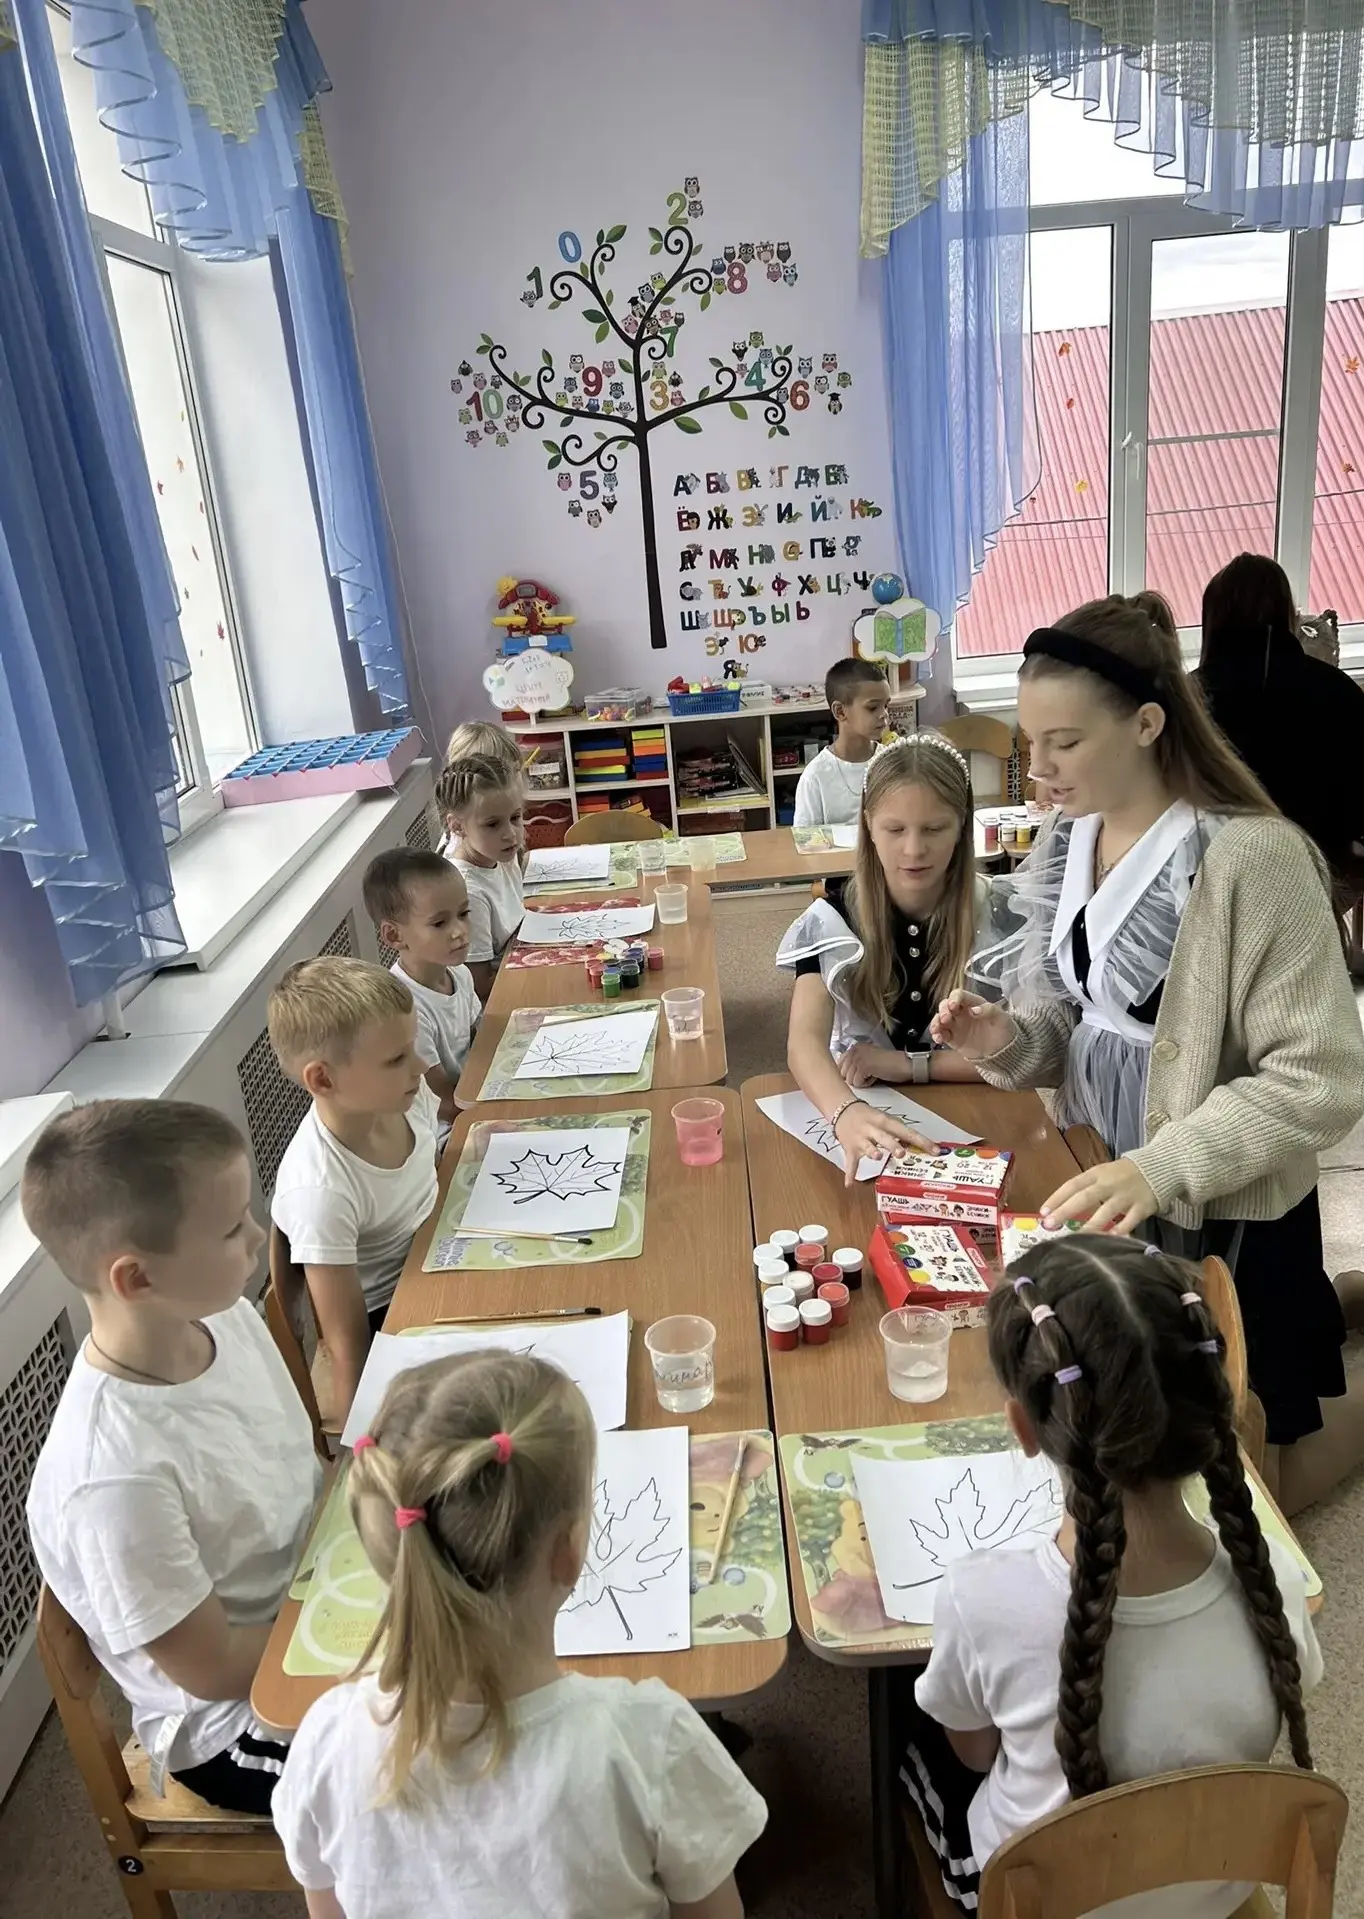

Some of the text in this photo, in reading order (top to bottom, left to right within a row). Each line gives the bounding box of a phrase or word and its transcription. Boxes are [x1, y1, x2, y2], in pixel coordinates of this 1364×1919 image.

[667, 192, 688, 225] 2
[558, 231, 582, 264] 0
[527, 266, 544, 299] 1
[727, 262, 748, 294] 8
[661, 326, 679, 358] 7
[582, 366, 603, 397] 9
[744, 361, 766, 391] 4
[465, 389, 504, 421] 10
[649, 379, 669, 411] 3
[790, 379, 810, 411] 6
[579, 470, 599, 500] 5
[707, 506, 730, 531] Ж
[771, 573, 787, 597] Ф
[853, 570, 868, 591] Ч
[680, 610, 701, 631] Ш
[748, 606, 766, 626] Ъ
[771, 603, 790, 624] Ы
[796, 601, 811, 621] Ь
[738, 633, 760, 654] Ю
[952, 1174, 995, 1185] ГУАШЬ
[881, 1195, 910, 1205] ГУАШЬ
[126, 1859, 137, 1872] 2
